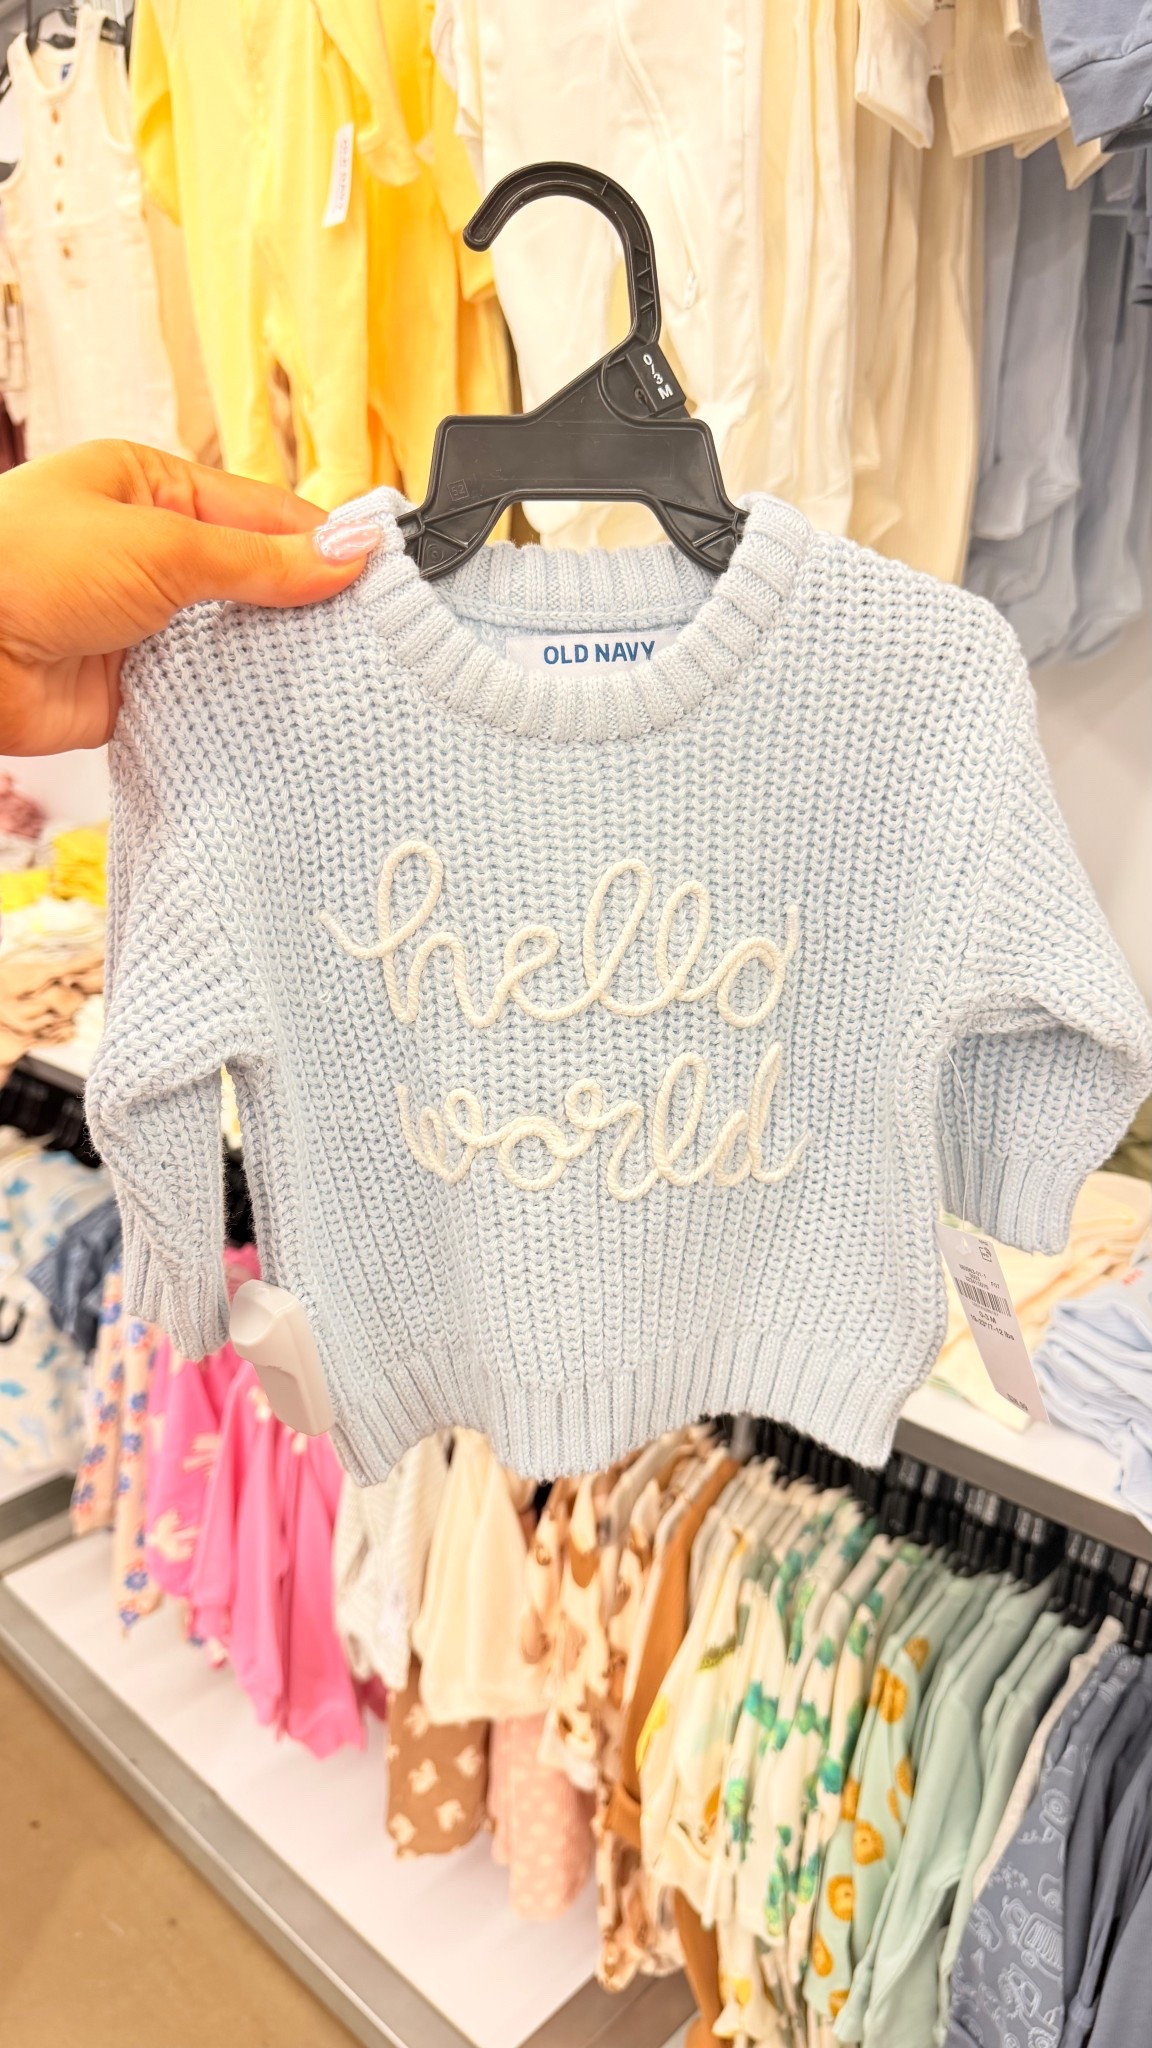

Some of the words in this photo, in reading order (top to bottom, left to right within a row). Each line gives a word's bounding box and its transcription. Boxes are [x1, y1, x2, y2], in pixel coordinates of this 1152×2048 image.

[657, 384, 674, 400] M
[543, 644, 589, 665] OLD
[595, 640, 656, 663] NAVY
[319, 840, 800, 1029] hello
[396, 1042, 812, 1201] world
